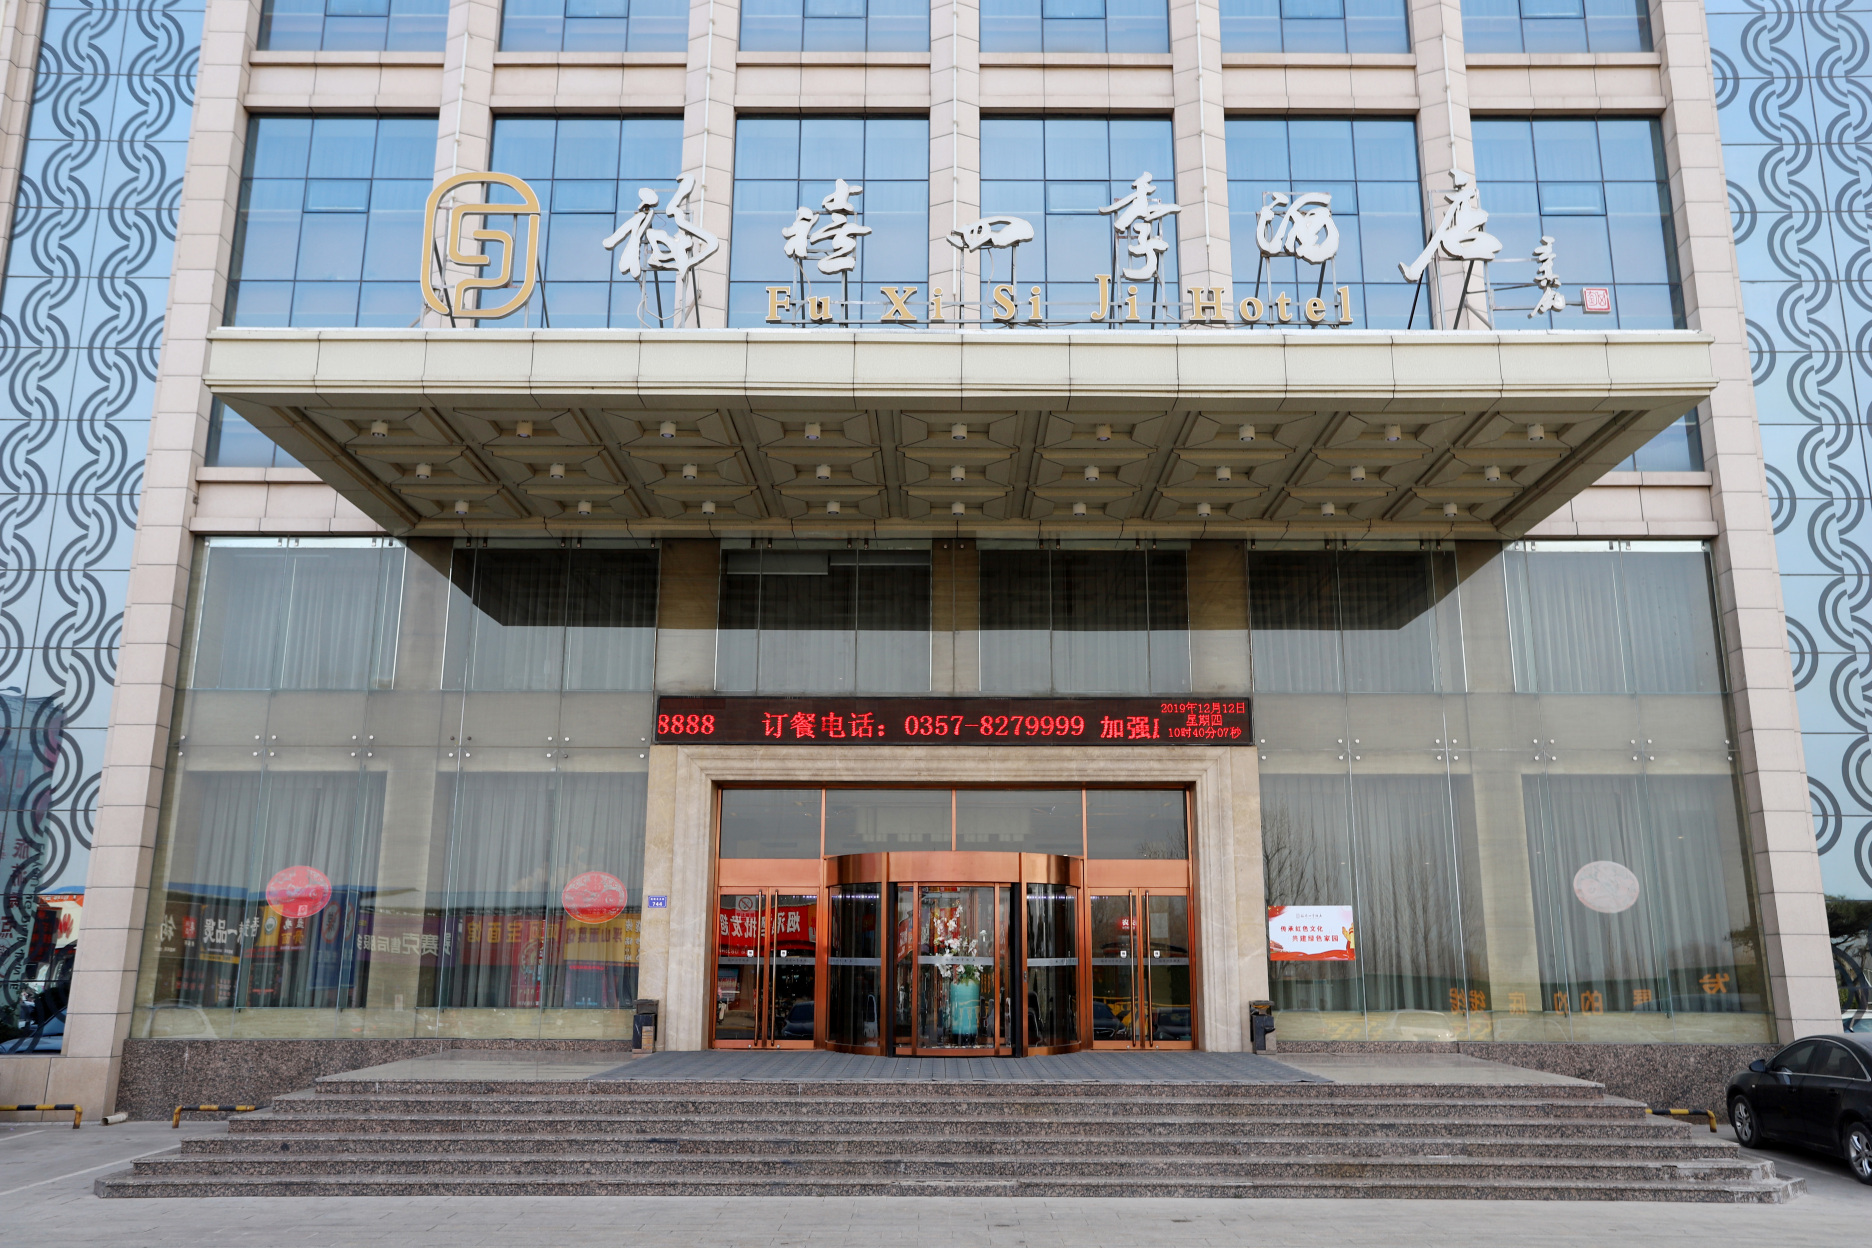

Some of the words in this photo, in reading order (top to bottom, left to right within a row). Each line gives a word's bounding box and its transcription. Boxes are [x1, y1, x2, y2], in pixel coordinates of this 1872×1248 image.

[765, 286, 833, 321] Fu
[880, 286, 944, 320] Xi
[992, 284, 1043, 321] Si
[1090, 274, 1140, 322] Ji
[1187, 285, 1353, 323] Hotel
[1160, 701, 1245, 714] 2019年12月12日
[657, 714, 715, 735] 8888
[904, 714, 1085, 736] 0357-8279999
[1186, 714, 1223, 726] 星期四
[1168, 726, 1242, 739] 10时40分07秒
